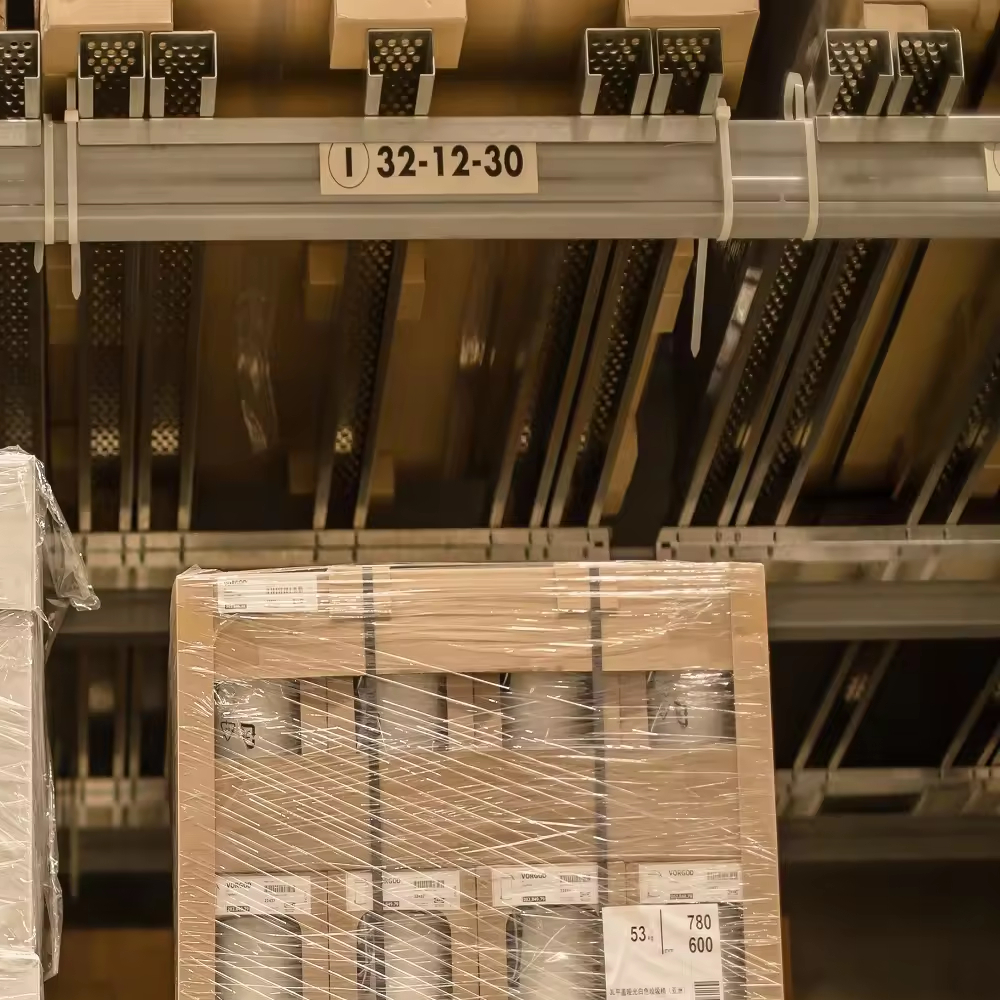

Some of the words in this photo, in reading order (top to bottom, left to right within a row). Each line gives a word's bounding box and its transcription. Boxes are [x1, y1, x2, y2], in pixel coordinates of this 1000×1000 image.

[376, 144, 524, 178] 32-12-30
[687, 914, 712, 930] 780
[630, 926, 647, 942] 53
[688, 936, 714, 953] 600
